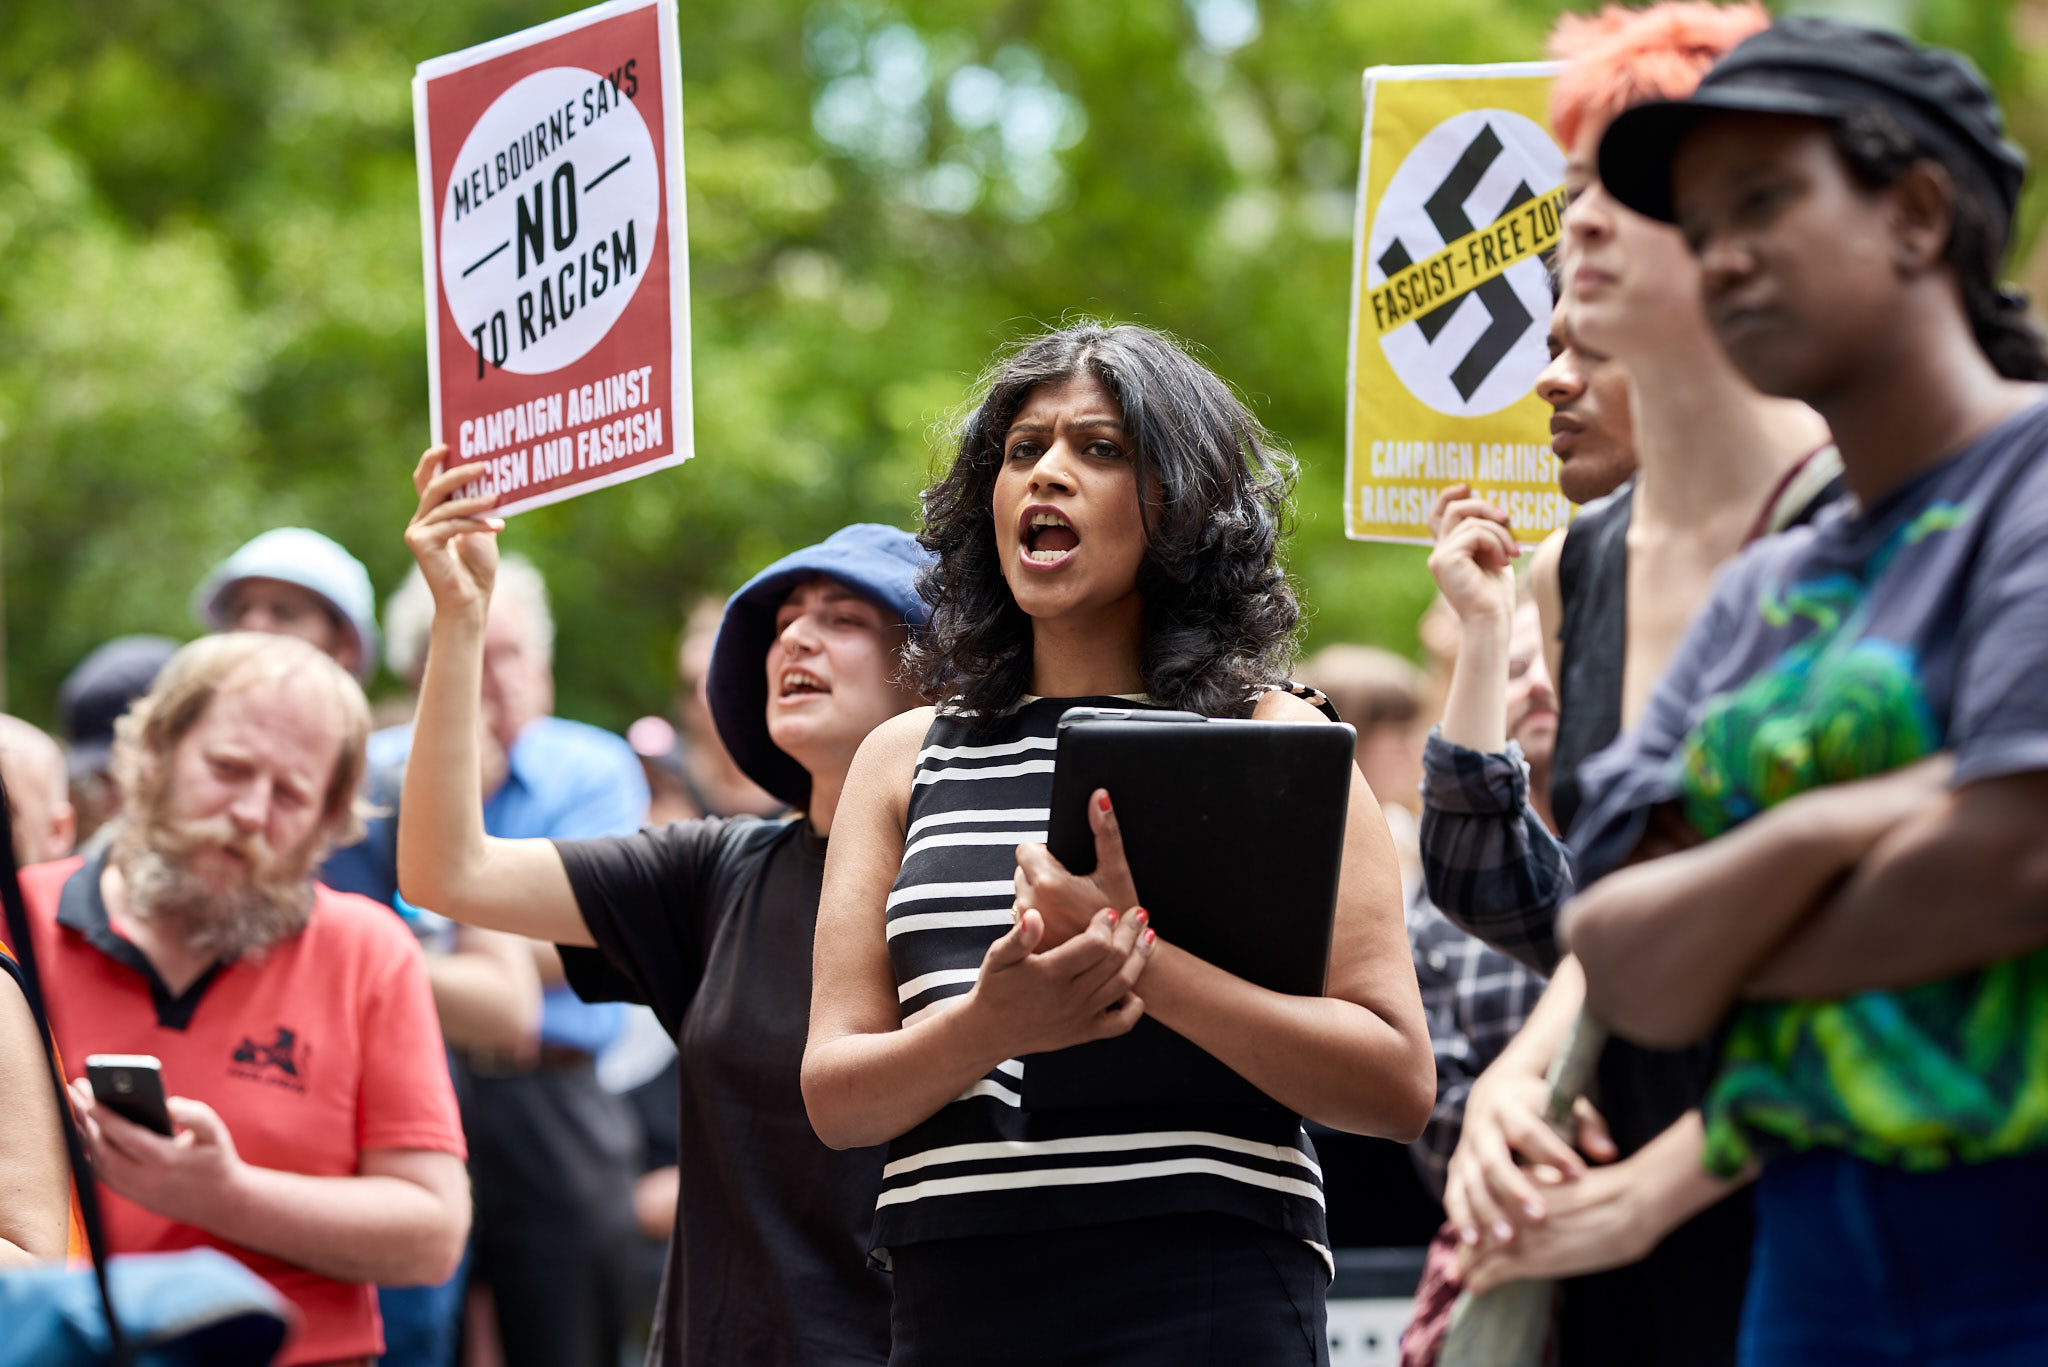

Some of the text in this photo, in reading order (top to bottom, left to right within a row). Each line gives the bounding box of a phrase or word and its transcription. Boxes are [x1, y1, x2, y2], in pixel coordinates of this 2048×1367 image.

[454, 59, 638, 222] MELBOURNE SAYS
[517, 161, 578, 279] NO
[1371, 190, 1567, 331] FASCIST-FREE ZON
[472, 219, 637, 381] TO RACISM
[459, 366, 652, 459] CAMPAIGN AGAINST
[533, 436, 573, 484] AND
[577, 408, 663, 470] FASCISM
[1371, 440, 1474, 480] CAMPAIGN
